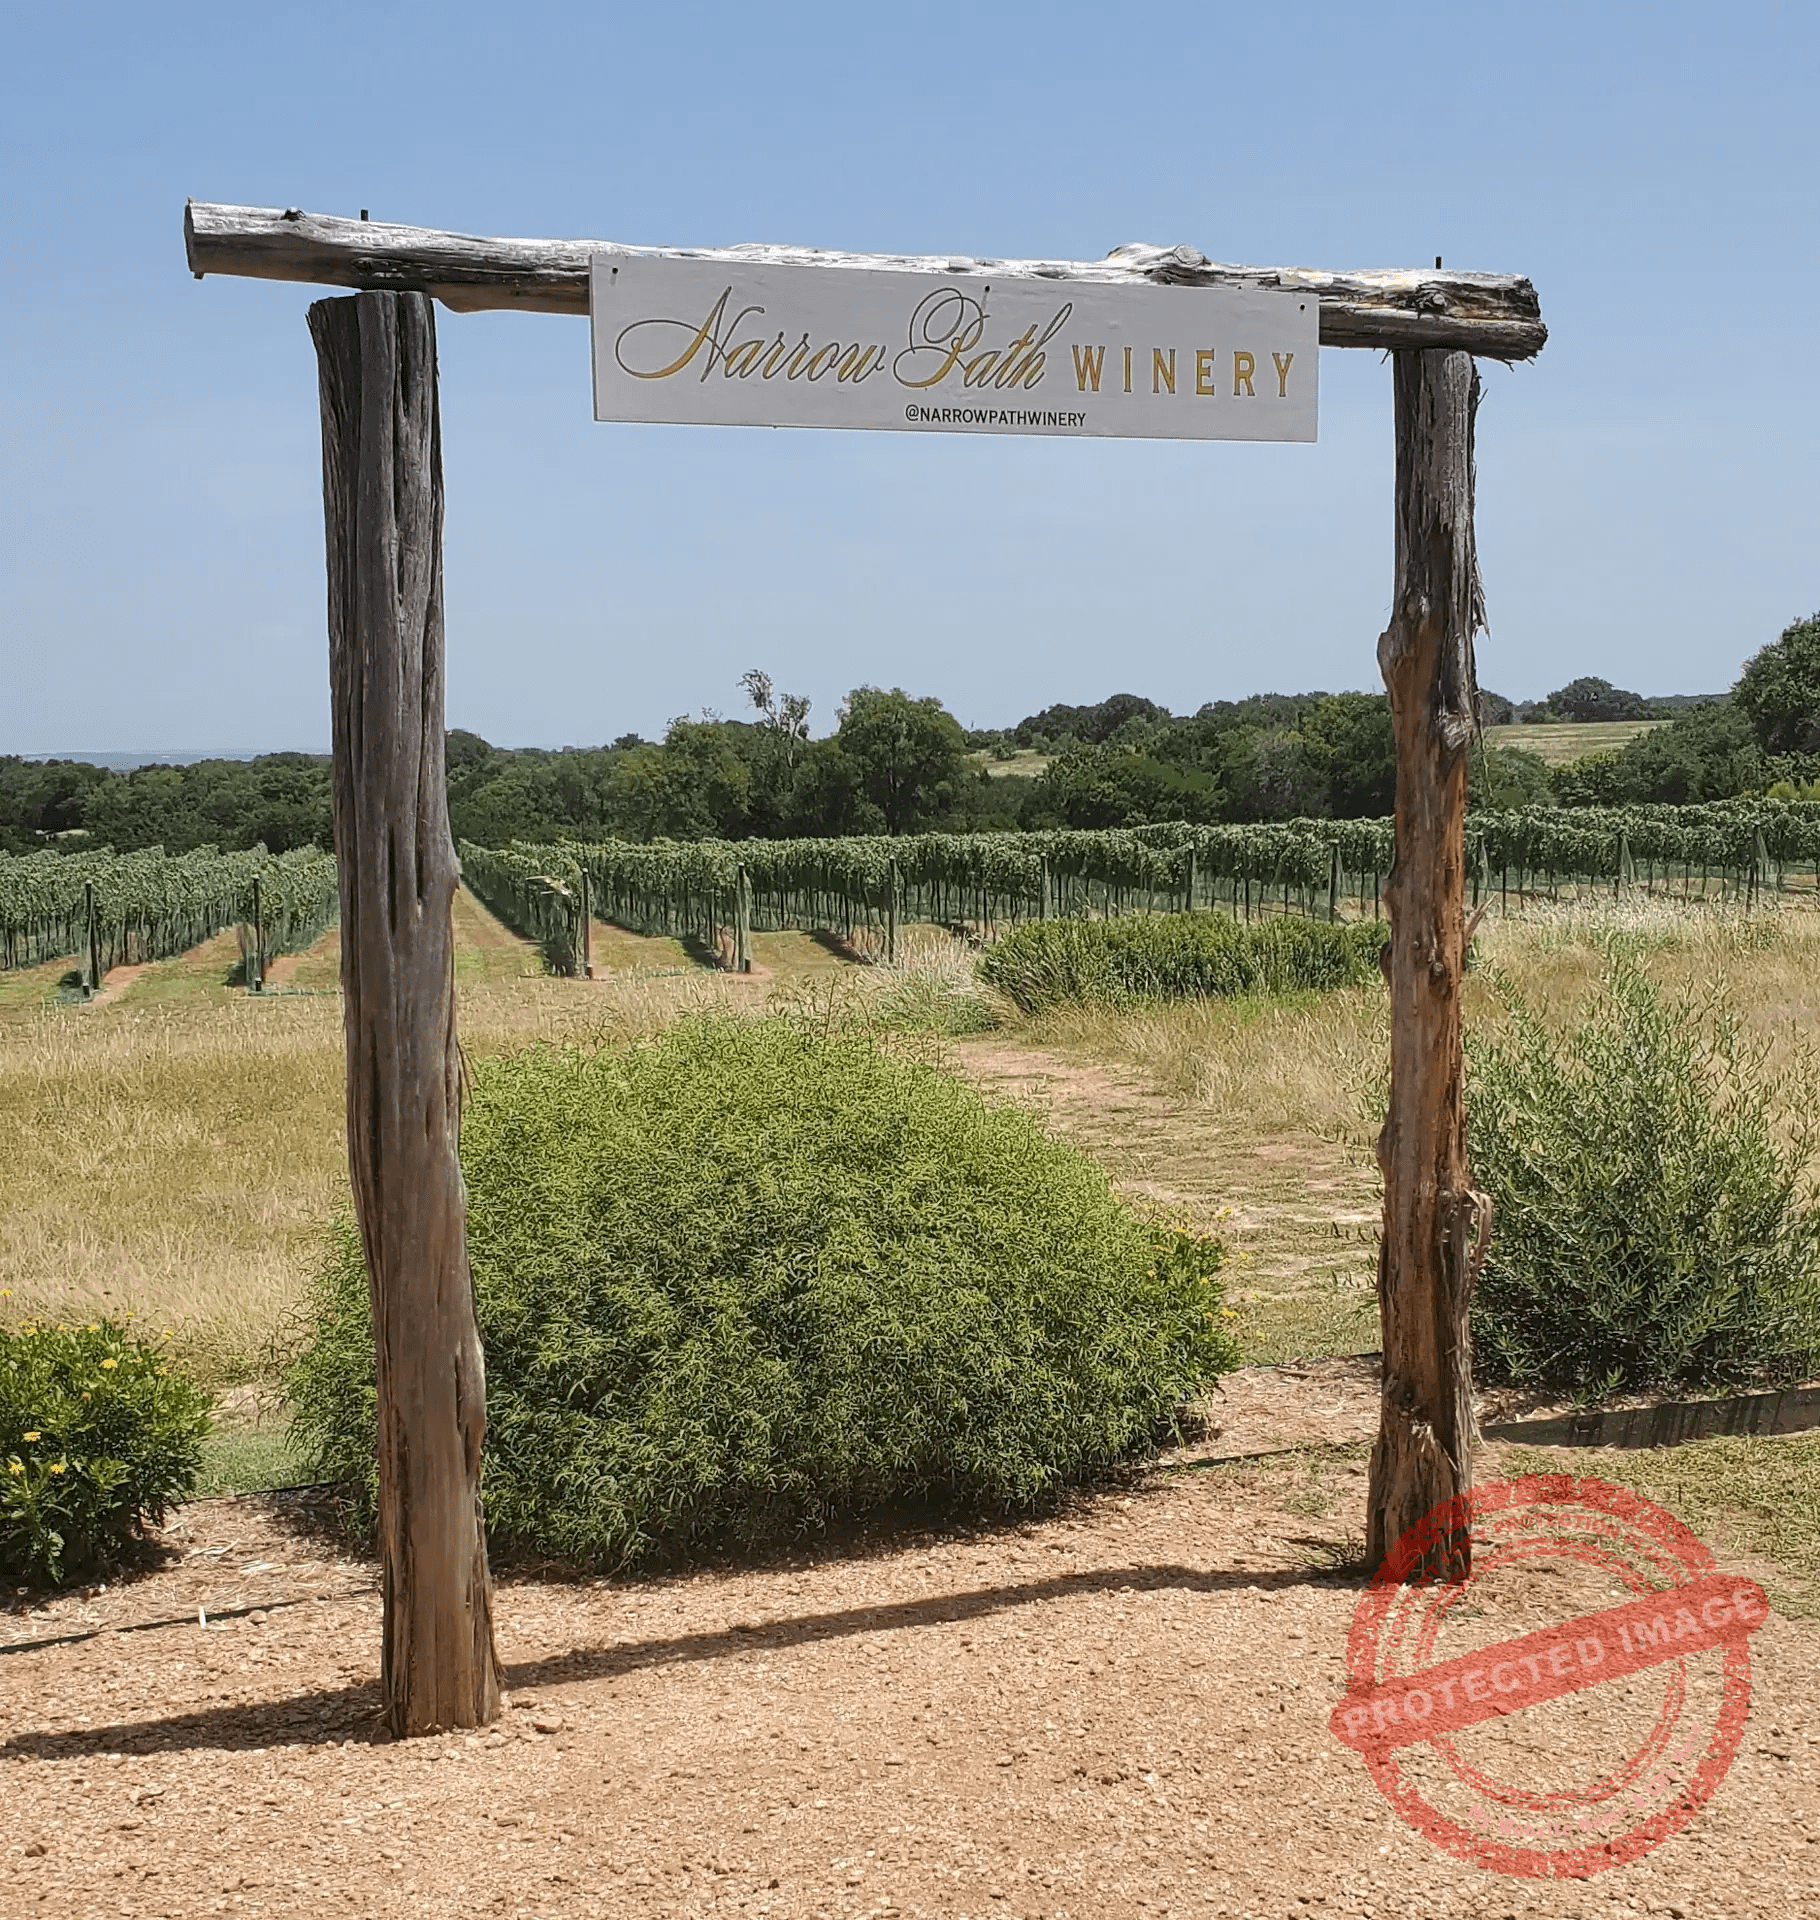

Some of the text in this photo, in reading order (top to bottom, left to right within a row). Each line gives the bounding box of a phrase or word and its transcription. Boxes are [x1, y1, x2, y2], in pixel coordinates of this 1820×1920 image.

[615, 286, 1294, 397] Narrow Path WINERY
[905, 403, 1086, 427] @NARROWPATHWINERY
